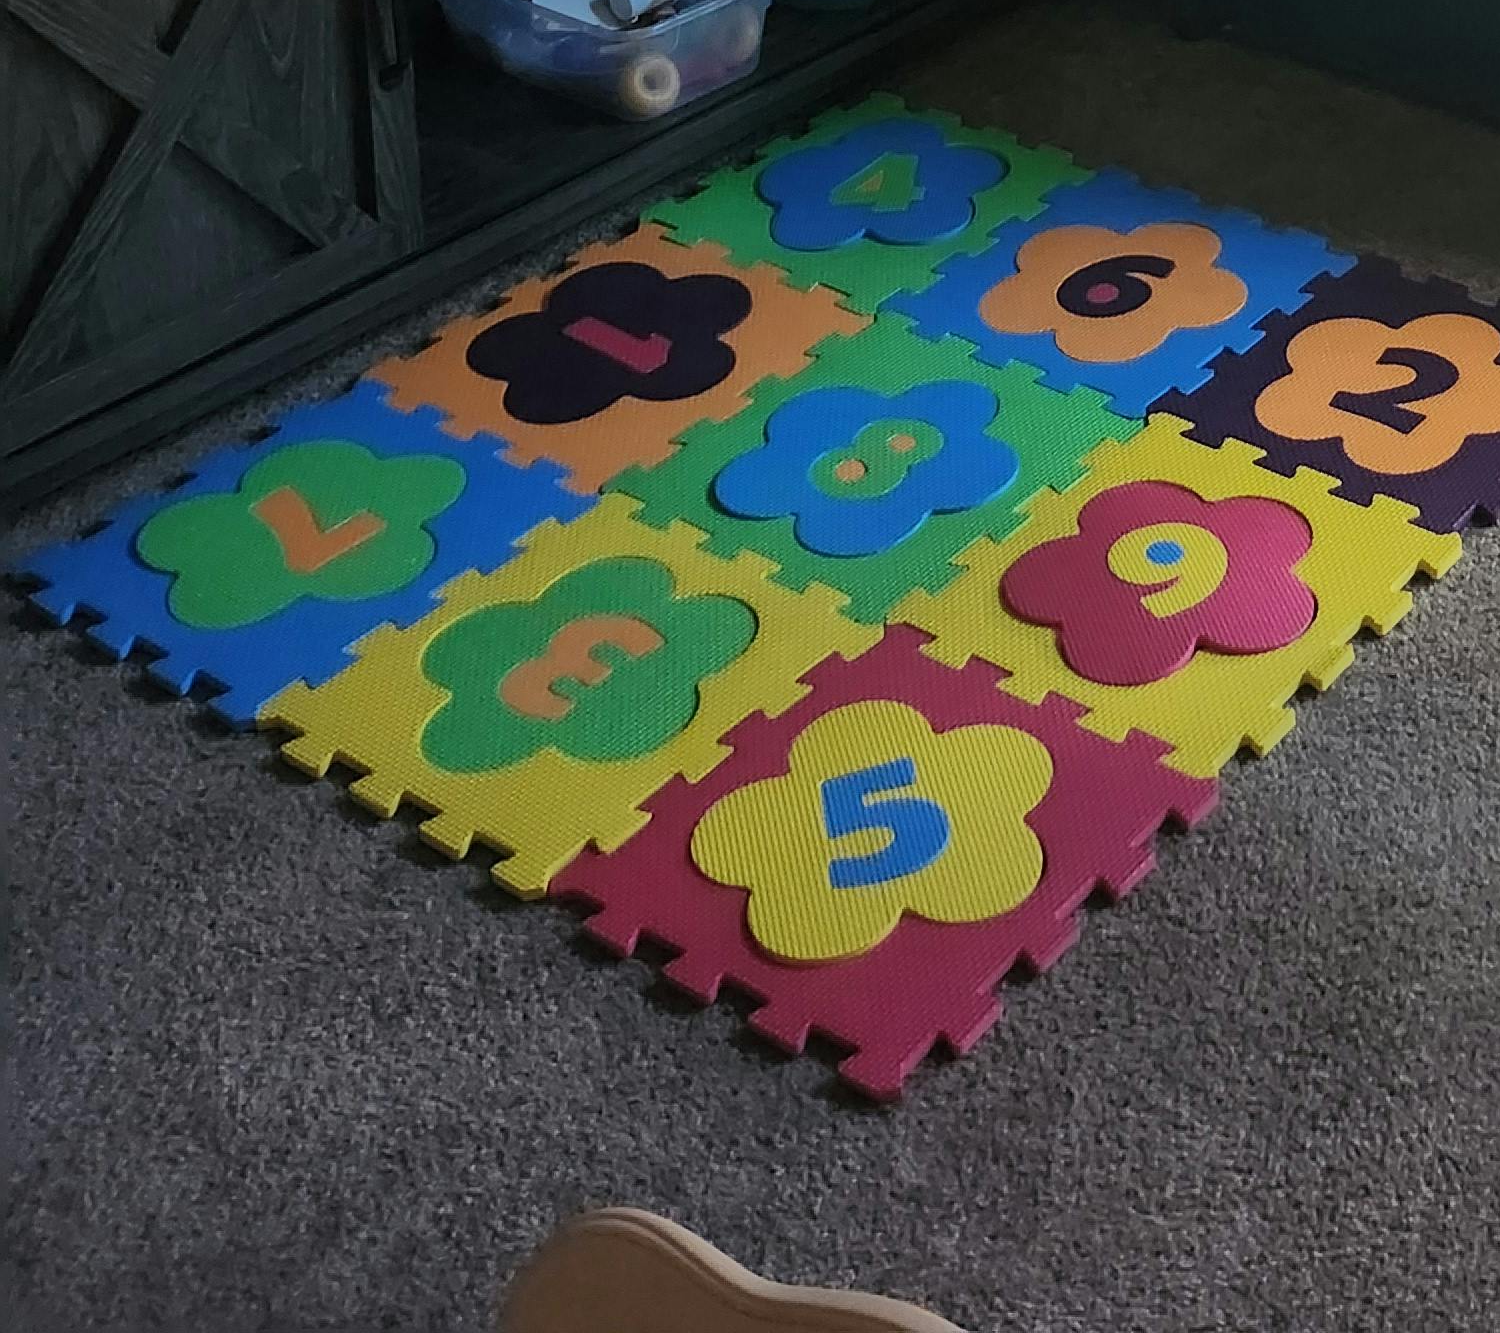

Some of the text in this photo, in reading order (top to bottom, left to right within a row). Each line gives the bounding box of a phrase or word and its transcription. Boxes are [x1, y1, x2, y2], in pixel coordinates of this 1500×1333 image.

[829, 152, 926, 212] 4
[1056, 254, 1175, 317] 6
[562, 315, 672, 374] 1
[1329, 347, 1459, 435] 2
[807, 417, 944, 498] 8
[249, 484, 386, 575] 7
[1106, 521, 1230, 620] 9
[497, 614, 666, 721] 3
[818, 757, 951, 891] 5
